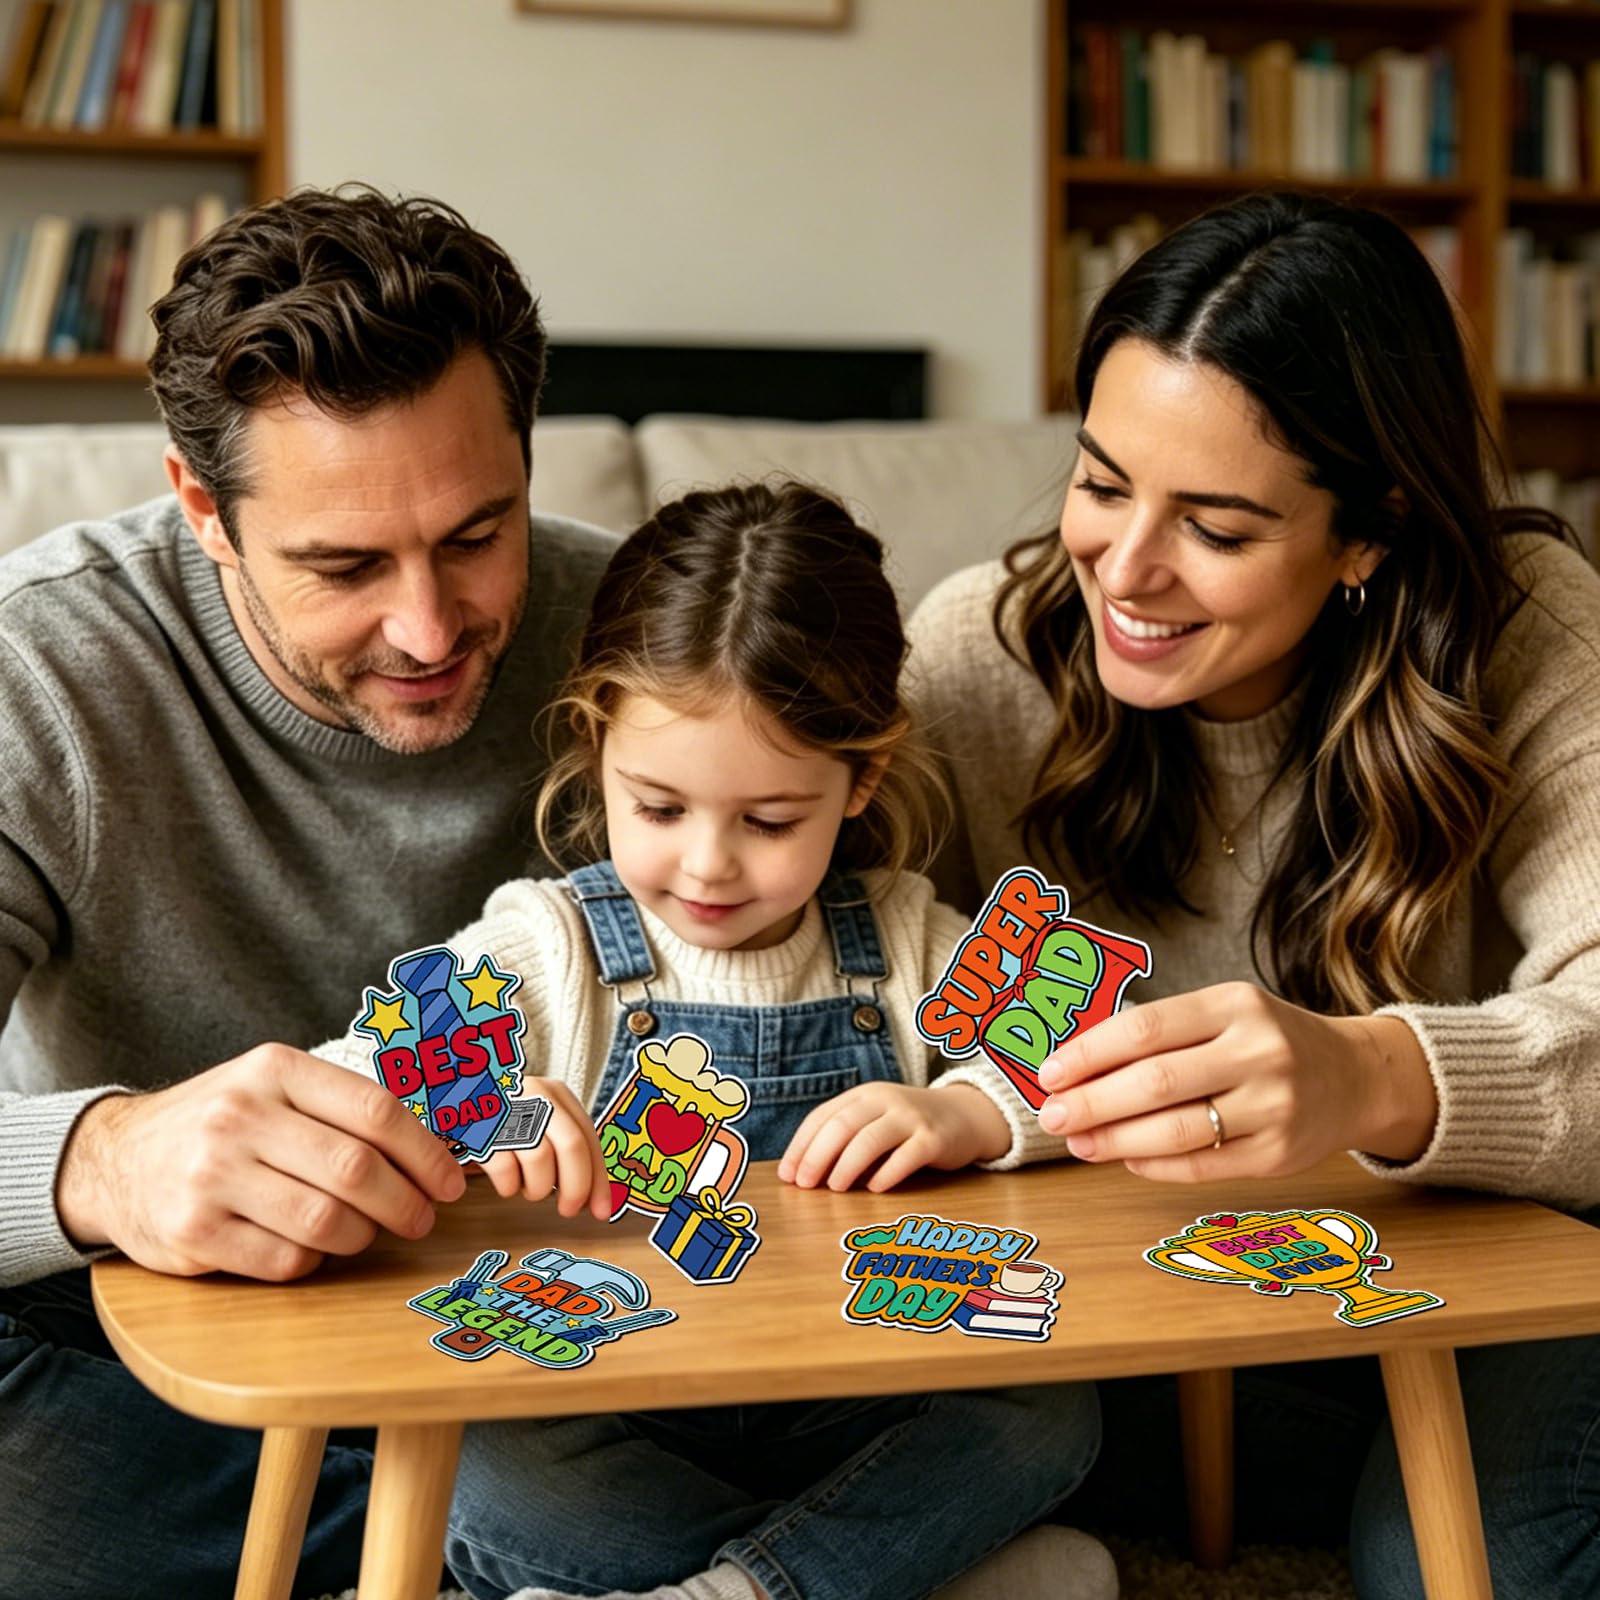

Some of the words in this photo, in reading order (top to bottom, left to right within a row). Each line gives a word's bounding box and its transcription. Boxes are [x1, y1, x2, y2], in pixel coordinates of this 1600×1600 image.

[920, 876, 1058, 1049] SUPER
[984, 929, 1099, 1068] DAD
[378, 1014, 517, 1098] BEST
[434, 1094, 501, 1132] DAD
[614, 1079, 663, 1134] I
[601, 1123, 687, 1204] DAD
[896, 1220, 1026, 1260] HAPPY
[1206, 1224, 1307, 1257] BEST
[1238, 1239, 1330, 1269] DAD
[853, 1252, 998, 1286] FATHER'S
[1265, 1254, 1354, 1280] EVER
[490, 1293, 564, 1328] THE
[499, 1273, 601, 1316] DAD
[854, 1278, 960, 1321] DAY
[417, 1289, 581, 1363] LEGEND
